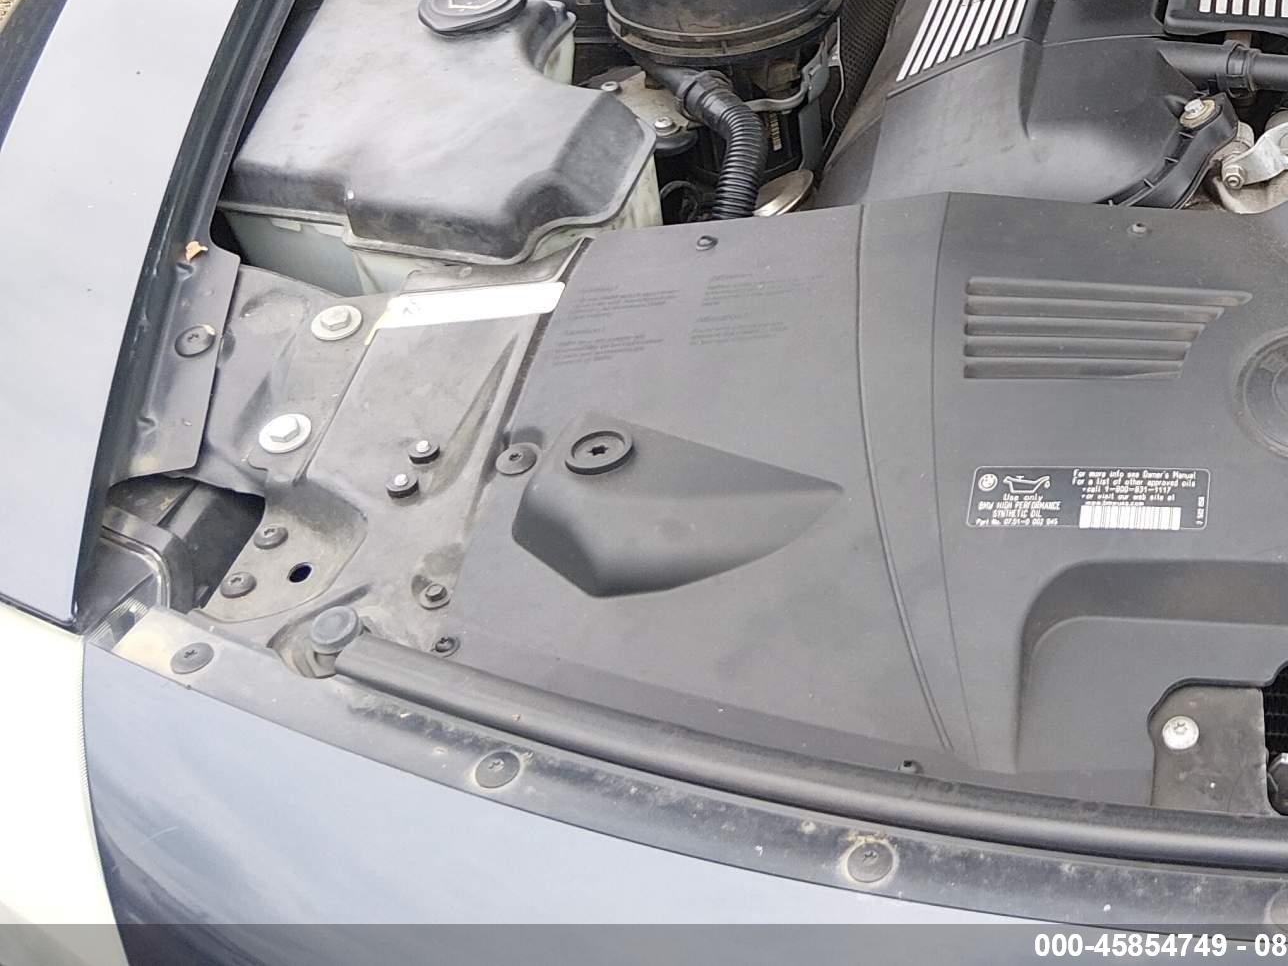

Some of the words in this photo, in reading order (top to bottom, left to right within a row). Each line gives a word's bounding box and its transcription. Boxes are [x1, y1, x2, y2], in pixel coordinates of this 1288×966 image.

[1109, 469, 1125, 479] info
[1172, 471, 1197, 481] Manual
[1124, 478, 1143, 487] other
[1147, 478, 1178, 488] approved
[1002, 493, 1019, 501] Use
[1023, 492, 1044, 502] only
[1014, 501, 1062, 511] PERFORMANCE
[1029, 509, 1043, 519] OIL
